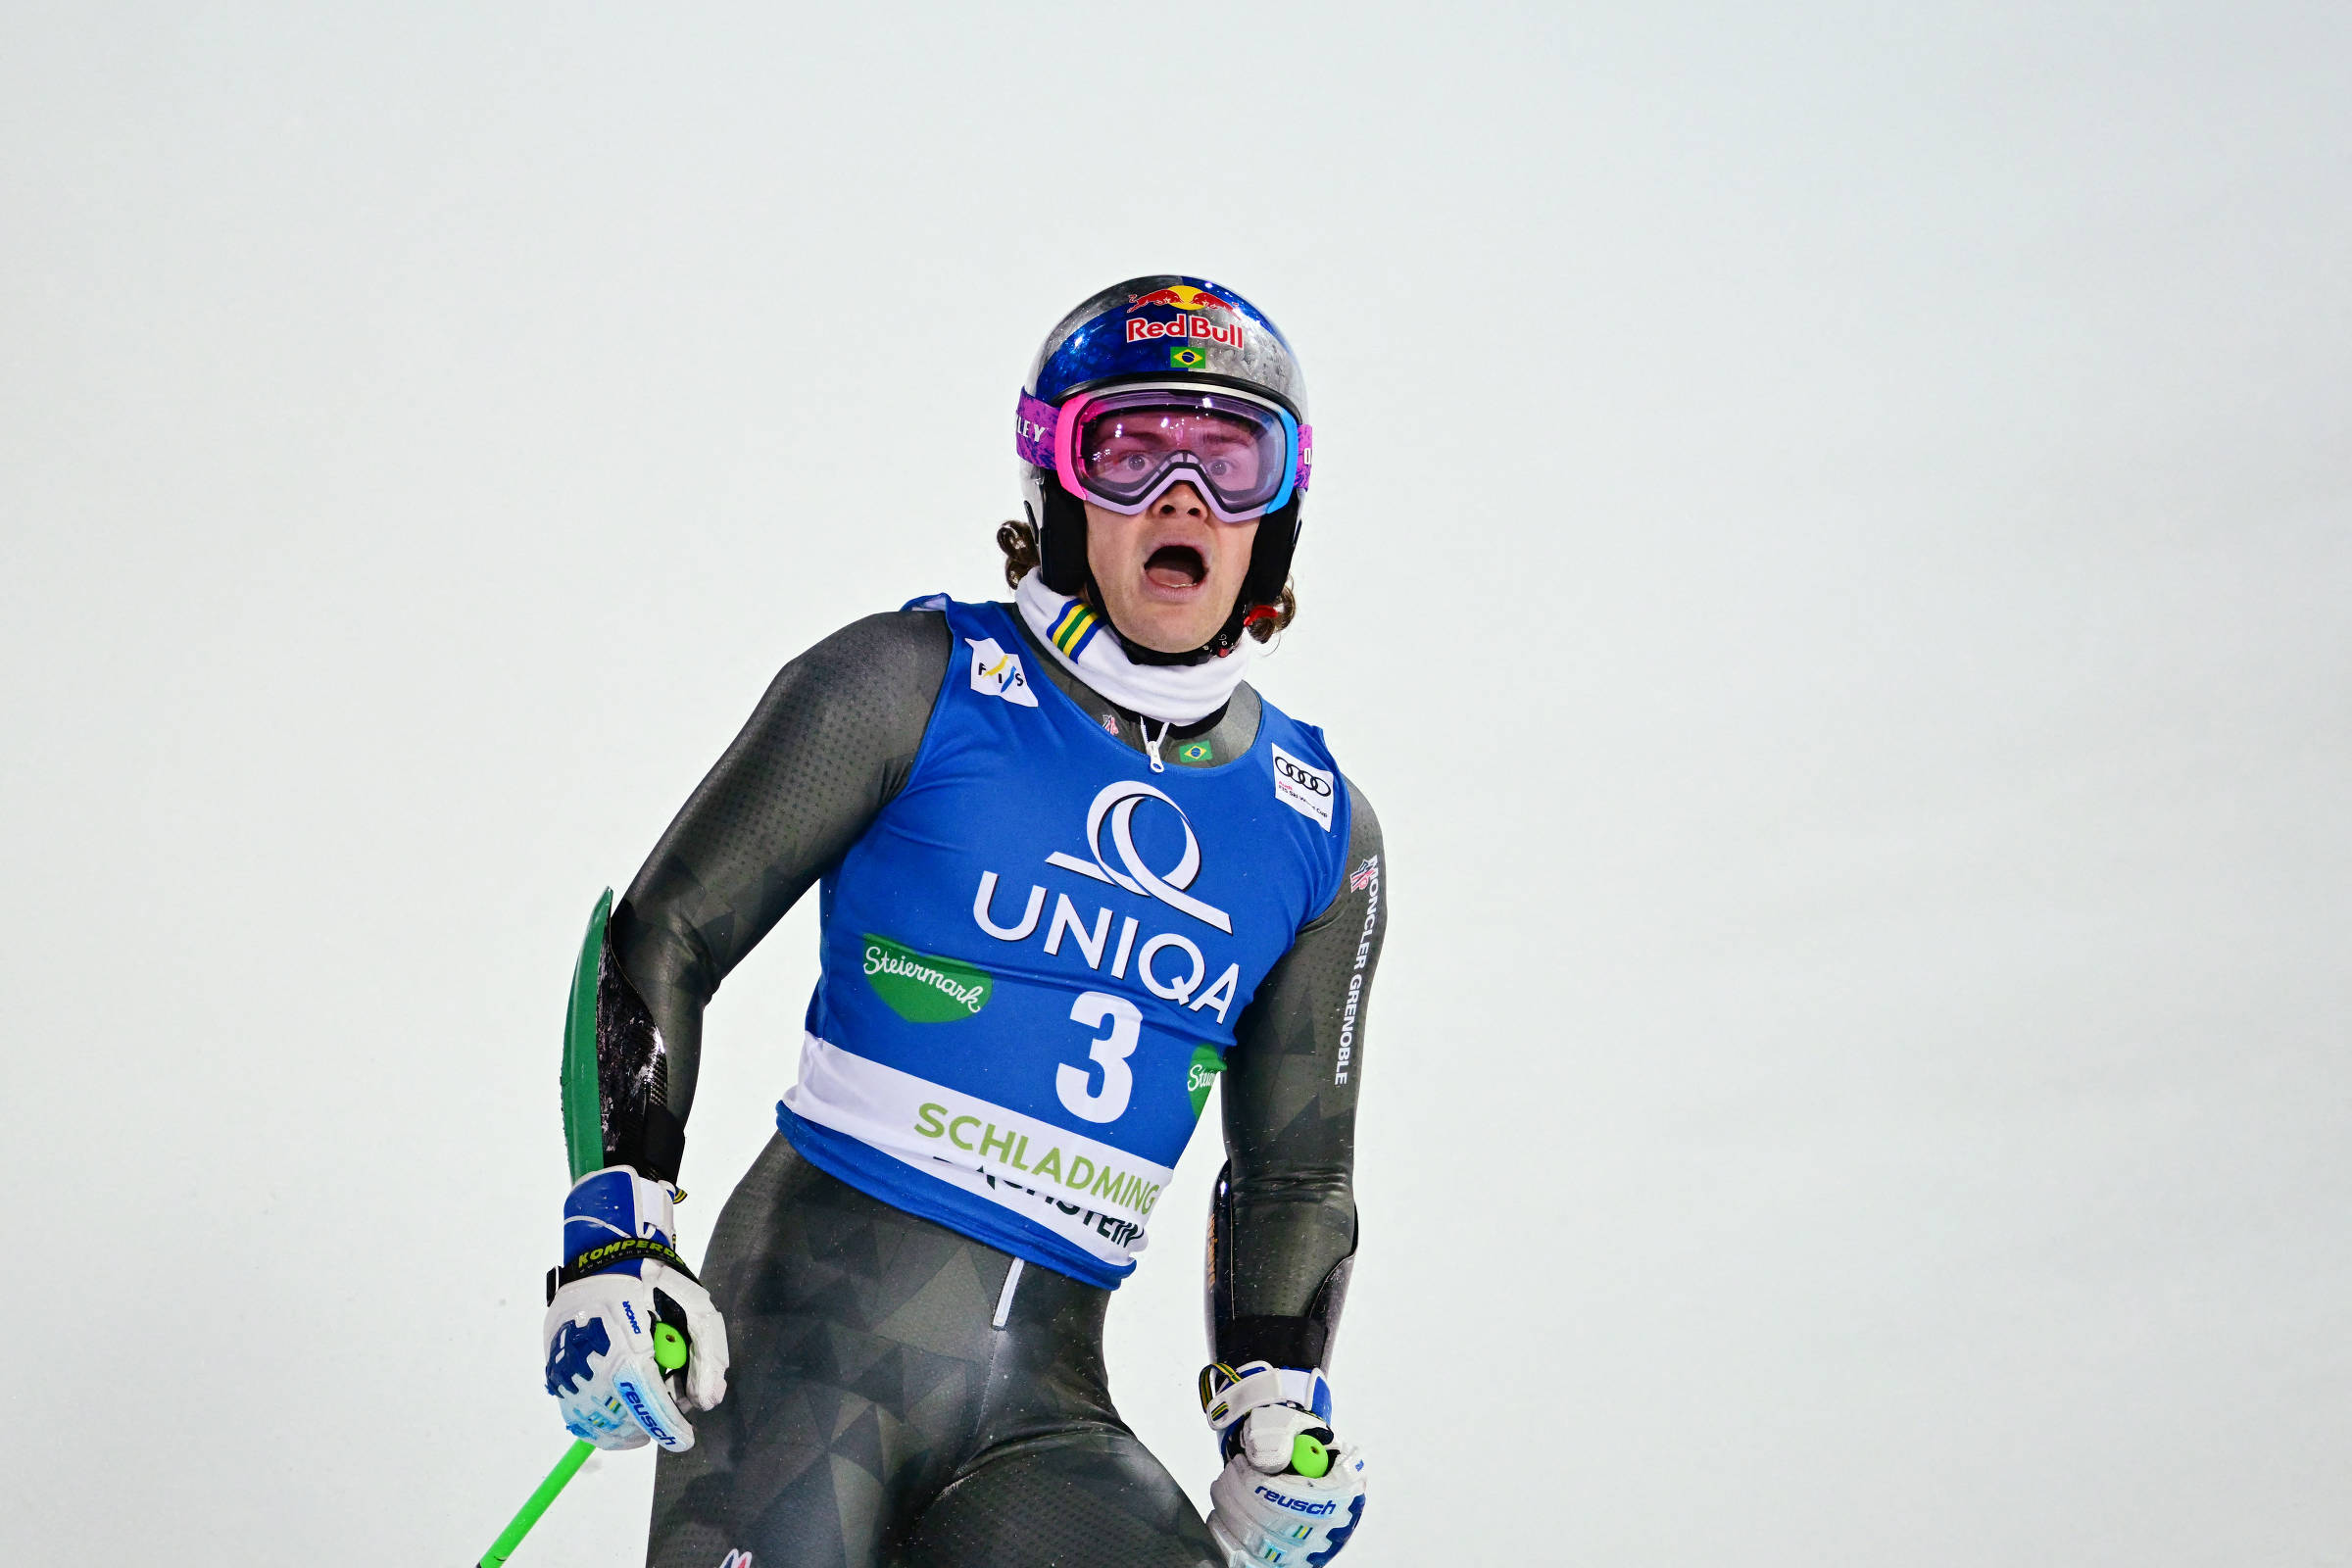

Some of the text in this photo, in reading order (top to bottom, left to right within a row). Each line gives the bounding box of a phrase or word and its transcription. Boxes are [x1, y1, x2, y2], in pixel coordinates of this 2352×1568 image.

[1126, 313, 1244, 350] Red Bull
[863, 946, 983, 1013] Steiermark
[973, 870, 1241, 1024] UNIQA
[1335, 855, 1379, 1087] MONCLER GRENOBLE
[1056, 991, 1144, 1124] 3
[914, 1102, 1159, 1215] SCHLADMING
[619, 1382, 676, 1446] reusch
[1254, 1486, 1337, 1515] reusch
